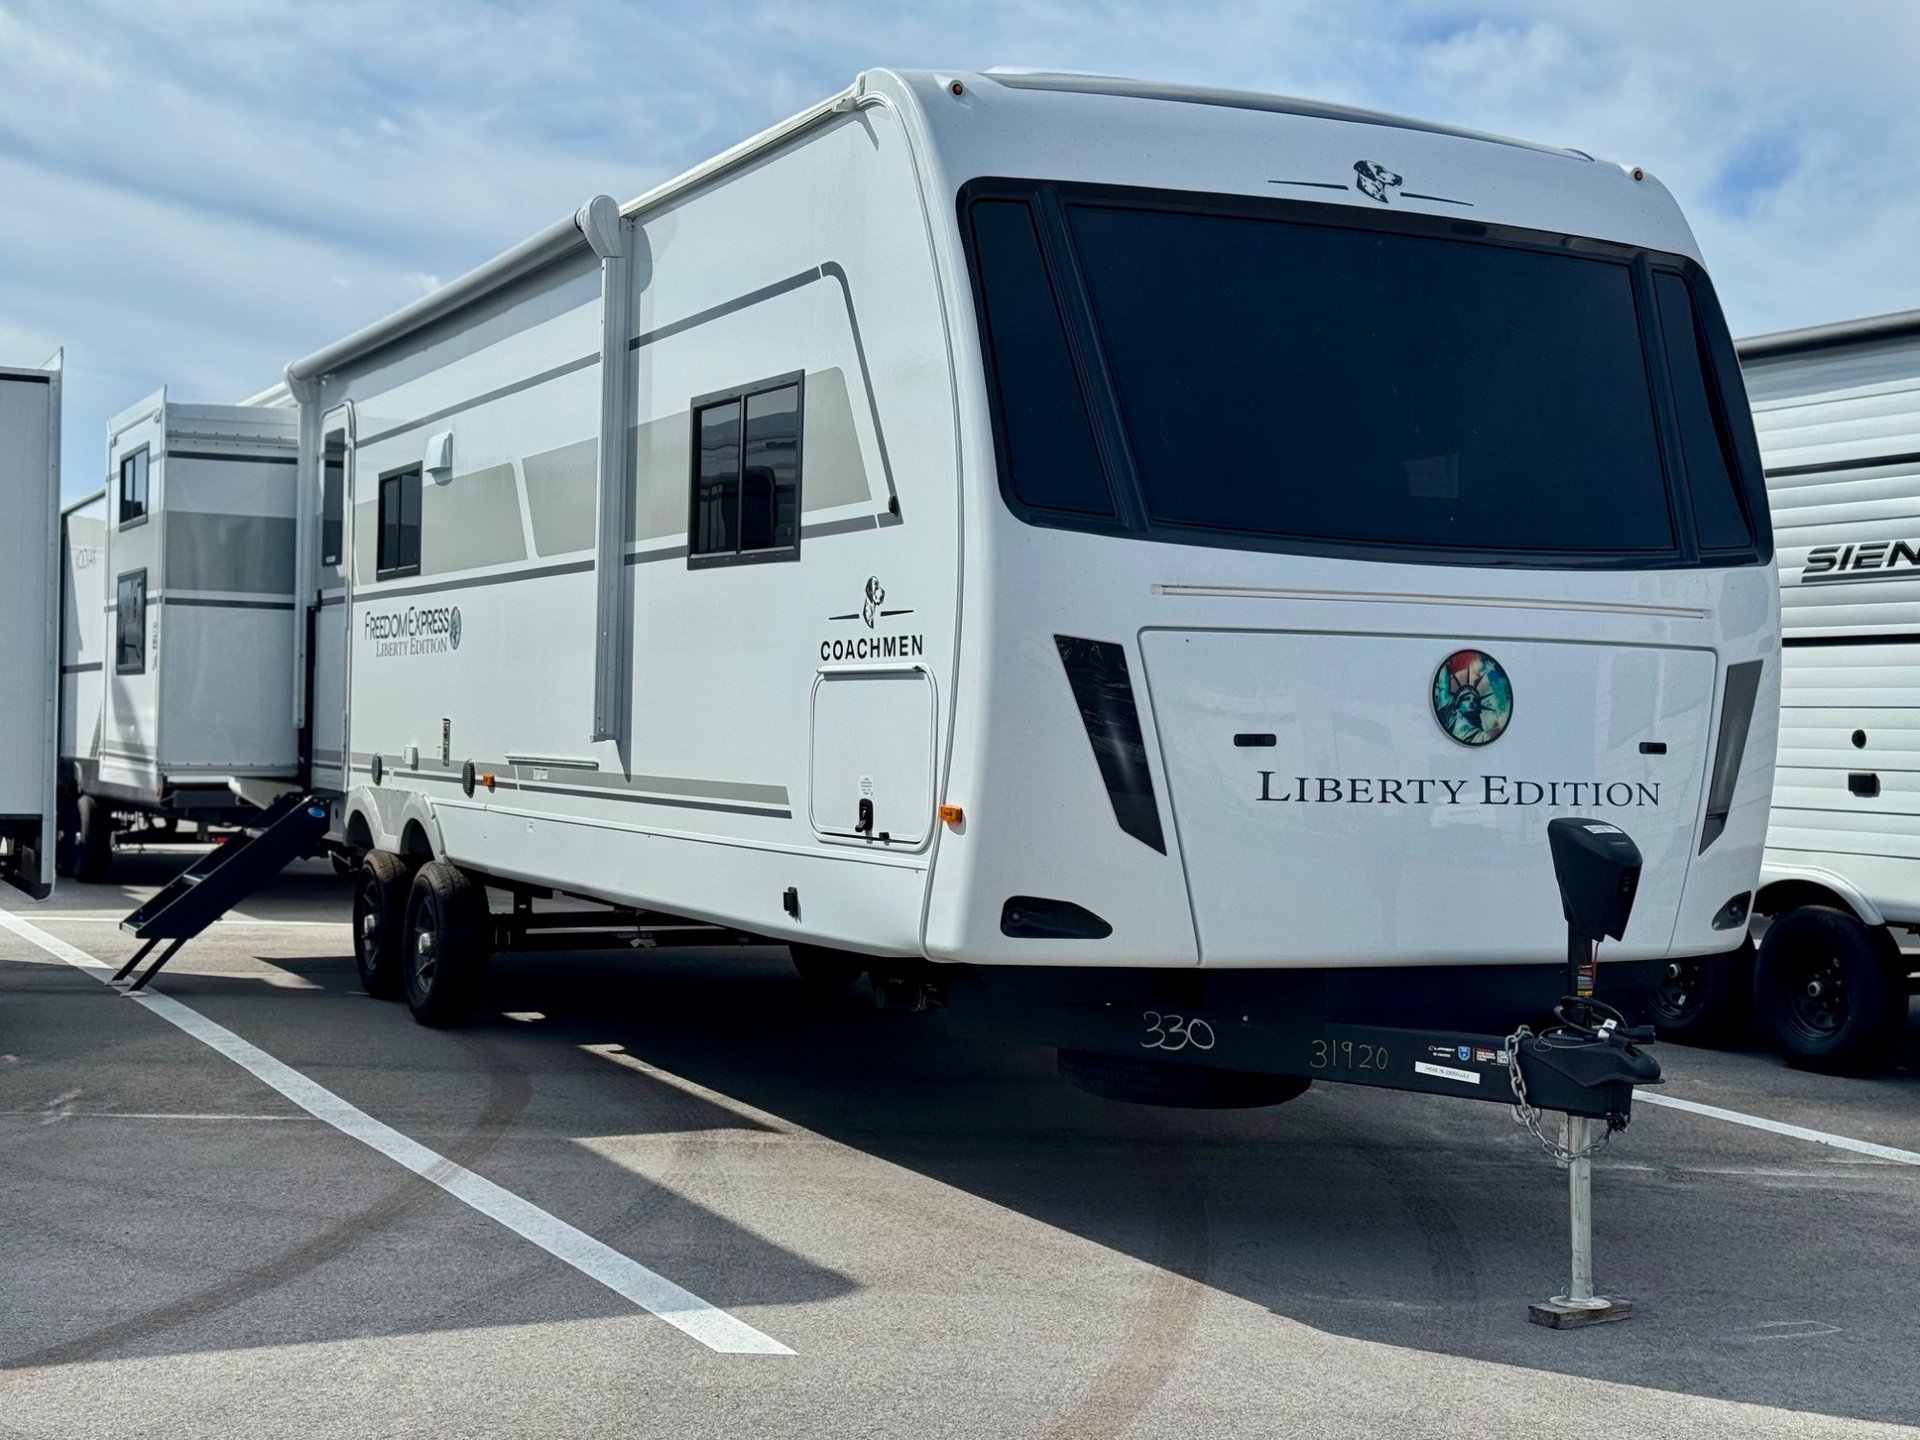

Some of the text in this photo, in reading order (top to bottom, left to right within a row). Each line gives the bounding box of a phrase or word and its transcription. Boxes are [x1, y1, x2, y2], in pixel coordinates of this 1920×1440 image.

[1801, 540, 1920, 574] SIEN
[364, 606, 450, 641] FREEDOM EXPRESS
[375, 637, 448, 658] LIBERTY EDITION
[820, 634, 923, 661] COACHMEN
[1256, 770, 1662, 808] LIBERTY EDITION
[1140, 1010, 1215, 1050] 330
[1309, 1039, 1389, 1071] 31920
